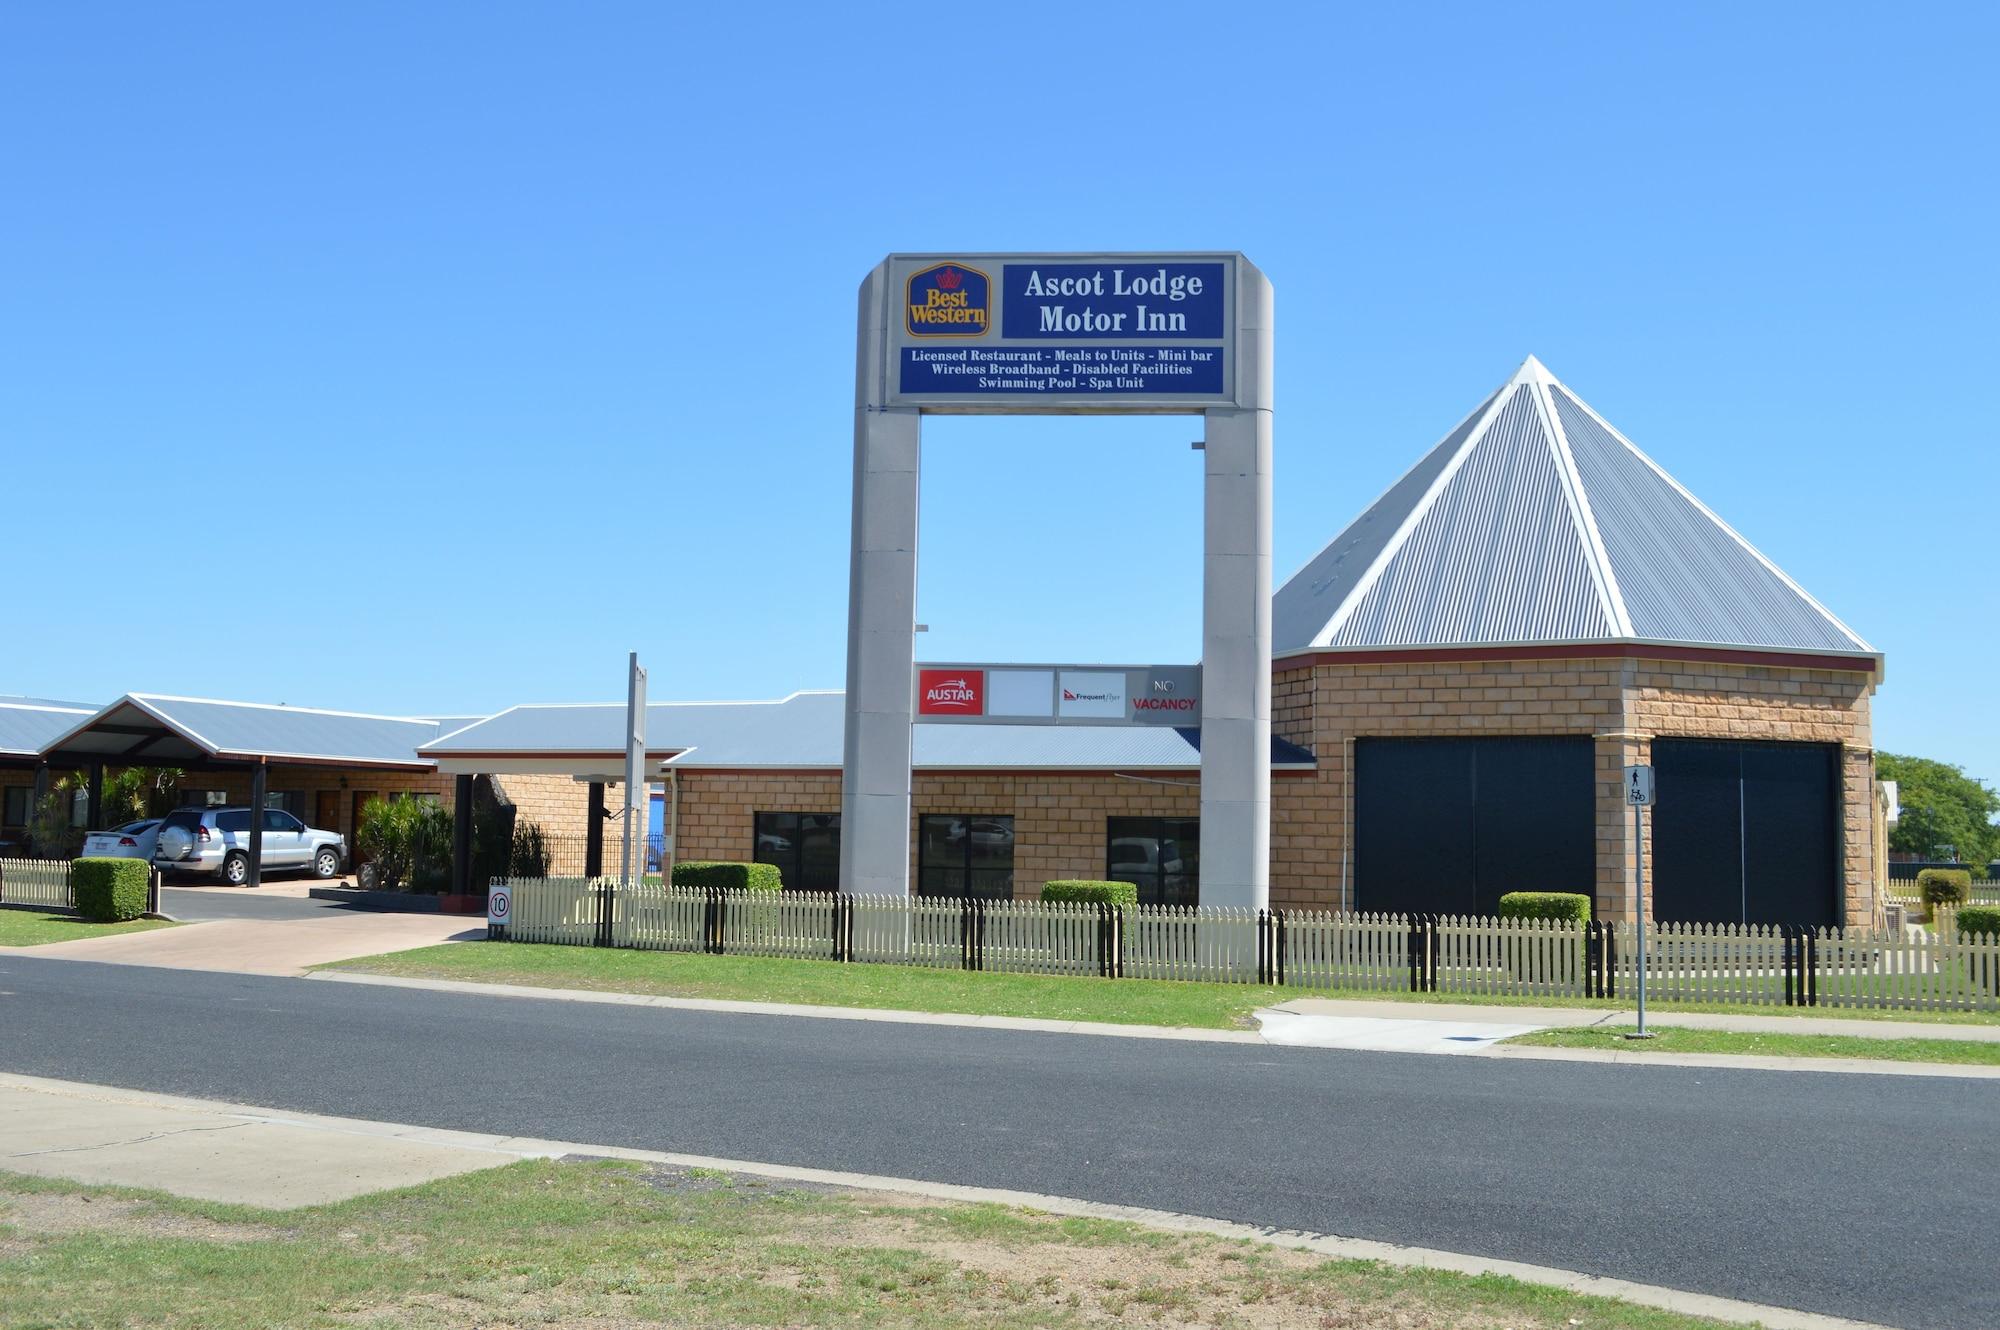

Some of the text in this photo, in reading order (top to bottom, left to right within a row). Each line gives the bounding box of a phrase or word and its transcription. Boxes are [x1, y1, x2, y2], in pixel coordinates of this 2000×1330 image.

[1024, 269, 1204, 301] Ascot Lodge
[926, 288, 968, 307] Best
[910, 304, 986, 324] Western
[1039, 304, 1187, 332] Motor Inn
[911, 350, 967, 361] Licensed
[970, 350, 1042, 361] Restaurant
[1054, 350, 1092, 361] Meals
[1095, 351, 1108, 361] to
[1111, 350, 1145, 361] Units
[1157, 350, 1187, 361] Mini
[1190, 350, 1213, 361] bar
[931, 363, 986, 375] Wireless
[989, 363, 1060, 375] Broadband
[1072, 363, 1128, 375] Disabled
[1132, 363, 1193, 375] Facilities
[979, 377, 1046, 390] Swimming
[1048, 377, 1076, 388] Pool
[1089, 377, 1113, 390] Spa
[1116, 377, 1144, 388] Unit
[1154, 680, 1175, 692] NO
[926, 689, 974, 701] AUSTAR
[1132, 698, 1197, 711] VACANCY
[494, 897, 506, 912] 10
